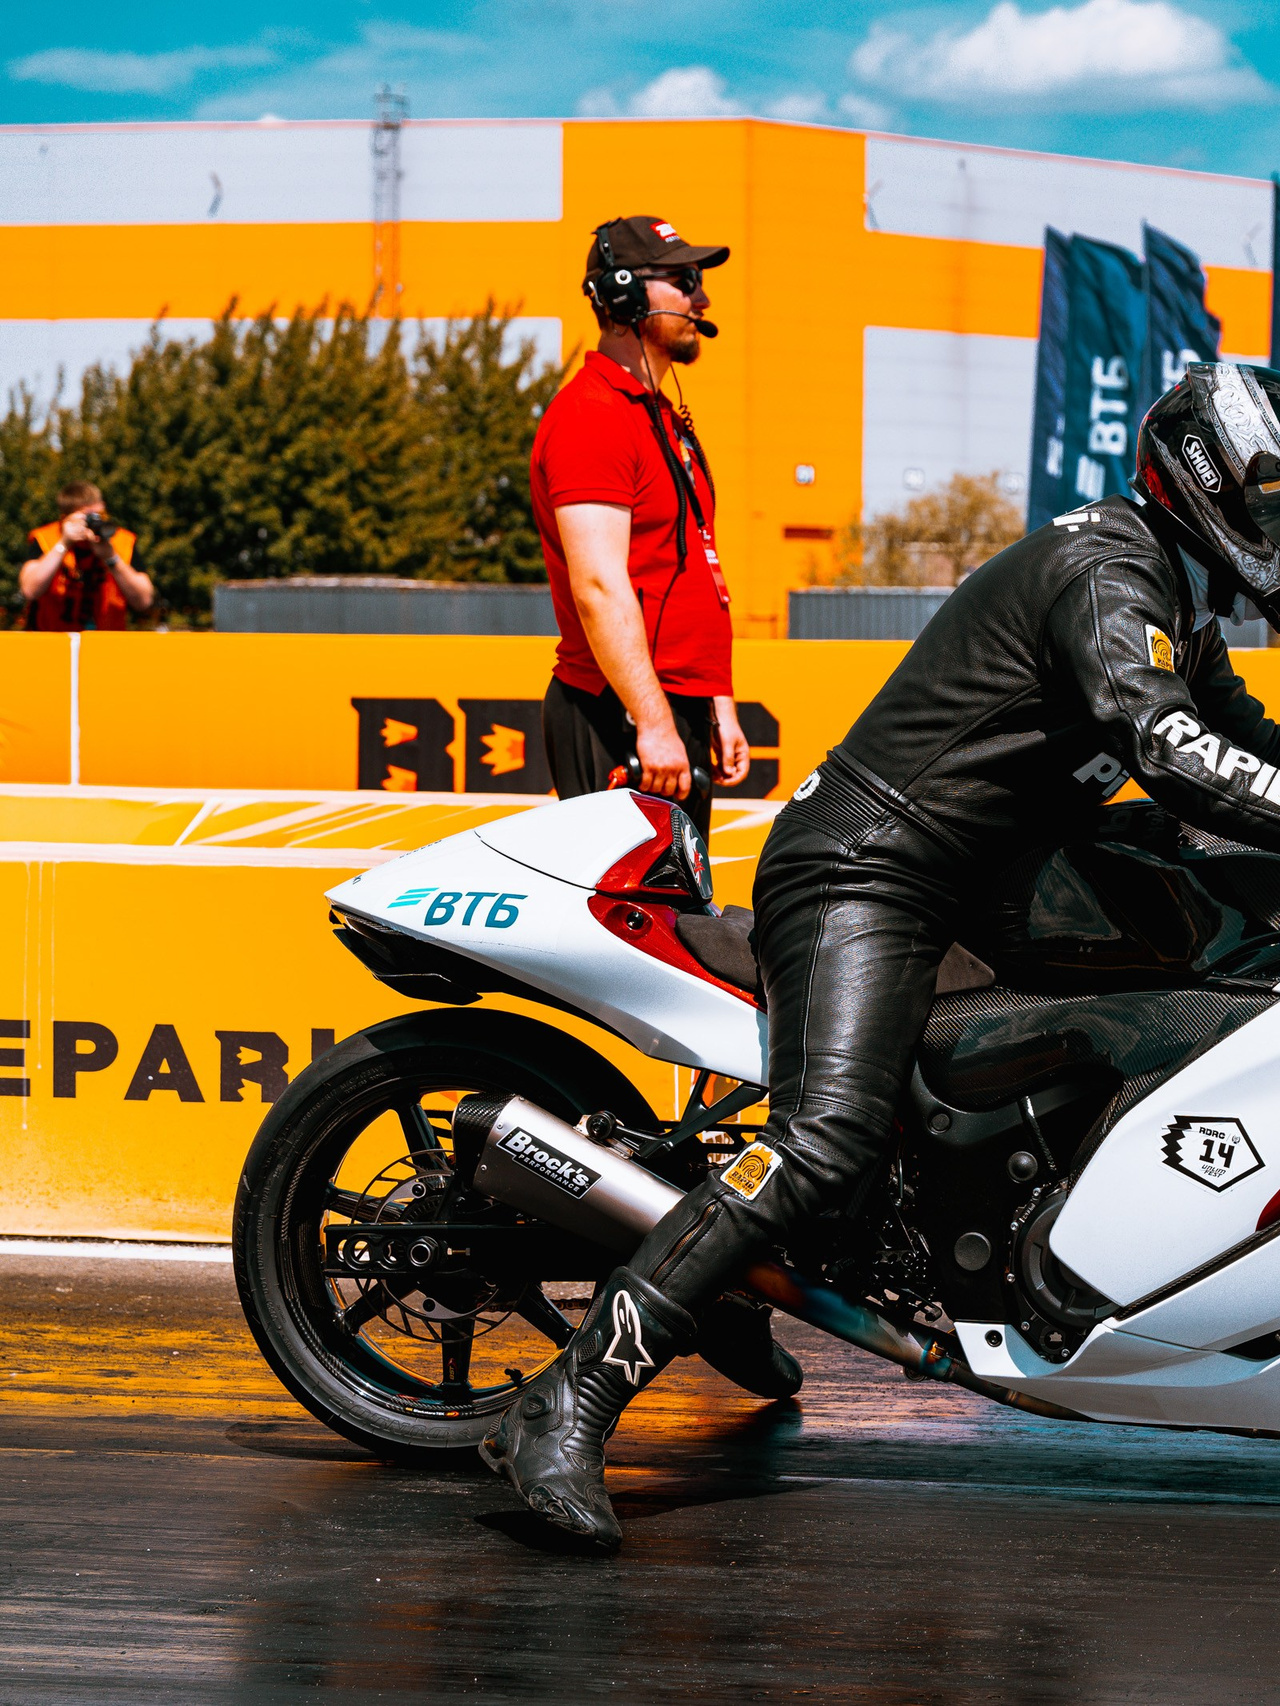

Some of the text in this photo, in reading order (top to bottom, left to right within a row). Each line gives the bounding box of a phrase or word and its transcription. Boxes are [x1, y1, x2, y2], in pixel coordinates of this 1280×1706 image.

[1088, 354, 1129, 456] ВТБ
[1185, 440, 1219, 488] SHOEI
[351, 697, 780, 799] RD
[423, 892, 528, 929] ВТБ
[1199, 1126, 1226, 1140] RDRC
[1199, 1138, 1235, 1168] 14
[505, 1130, 589, 1187] Brock's
[518, 1153, 580, 1193] PERFORMANCE
